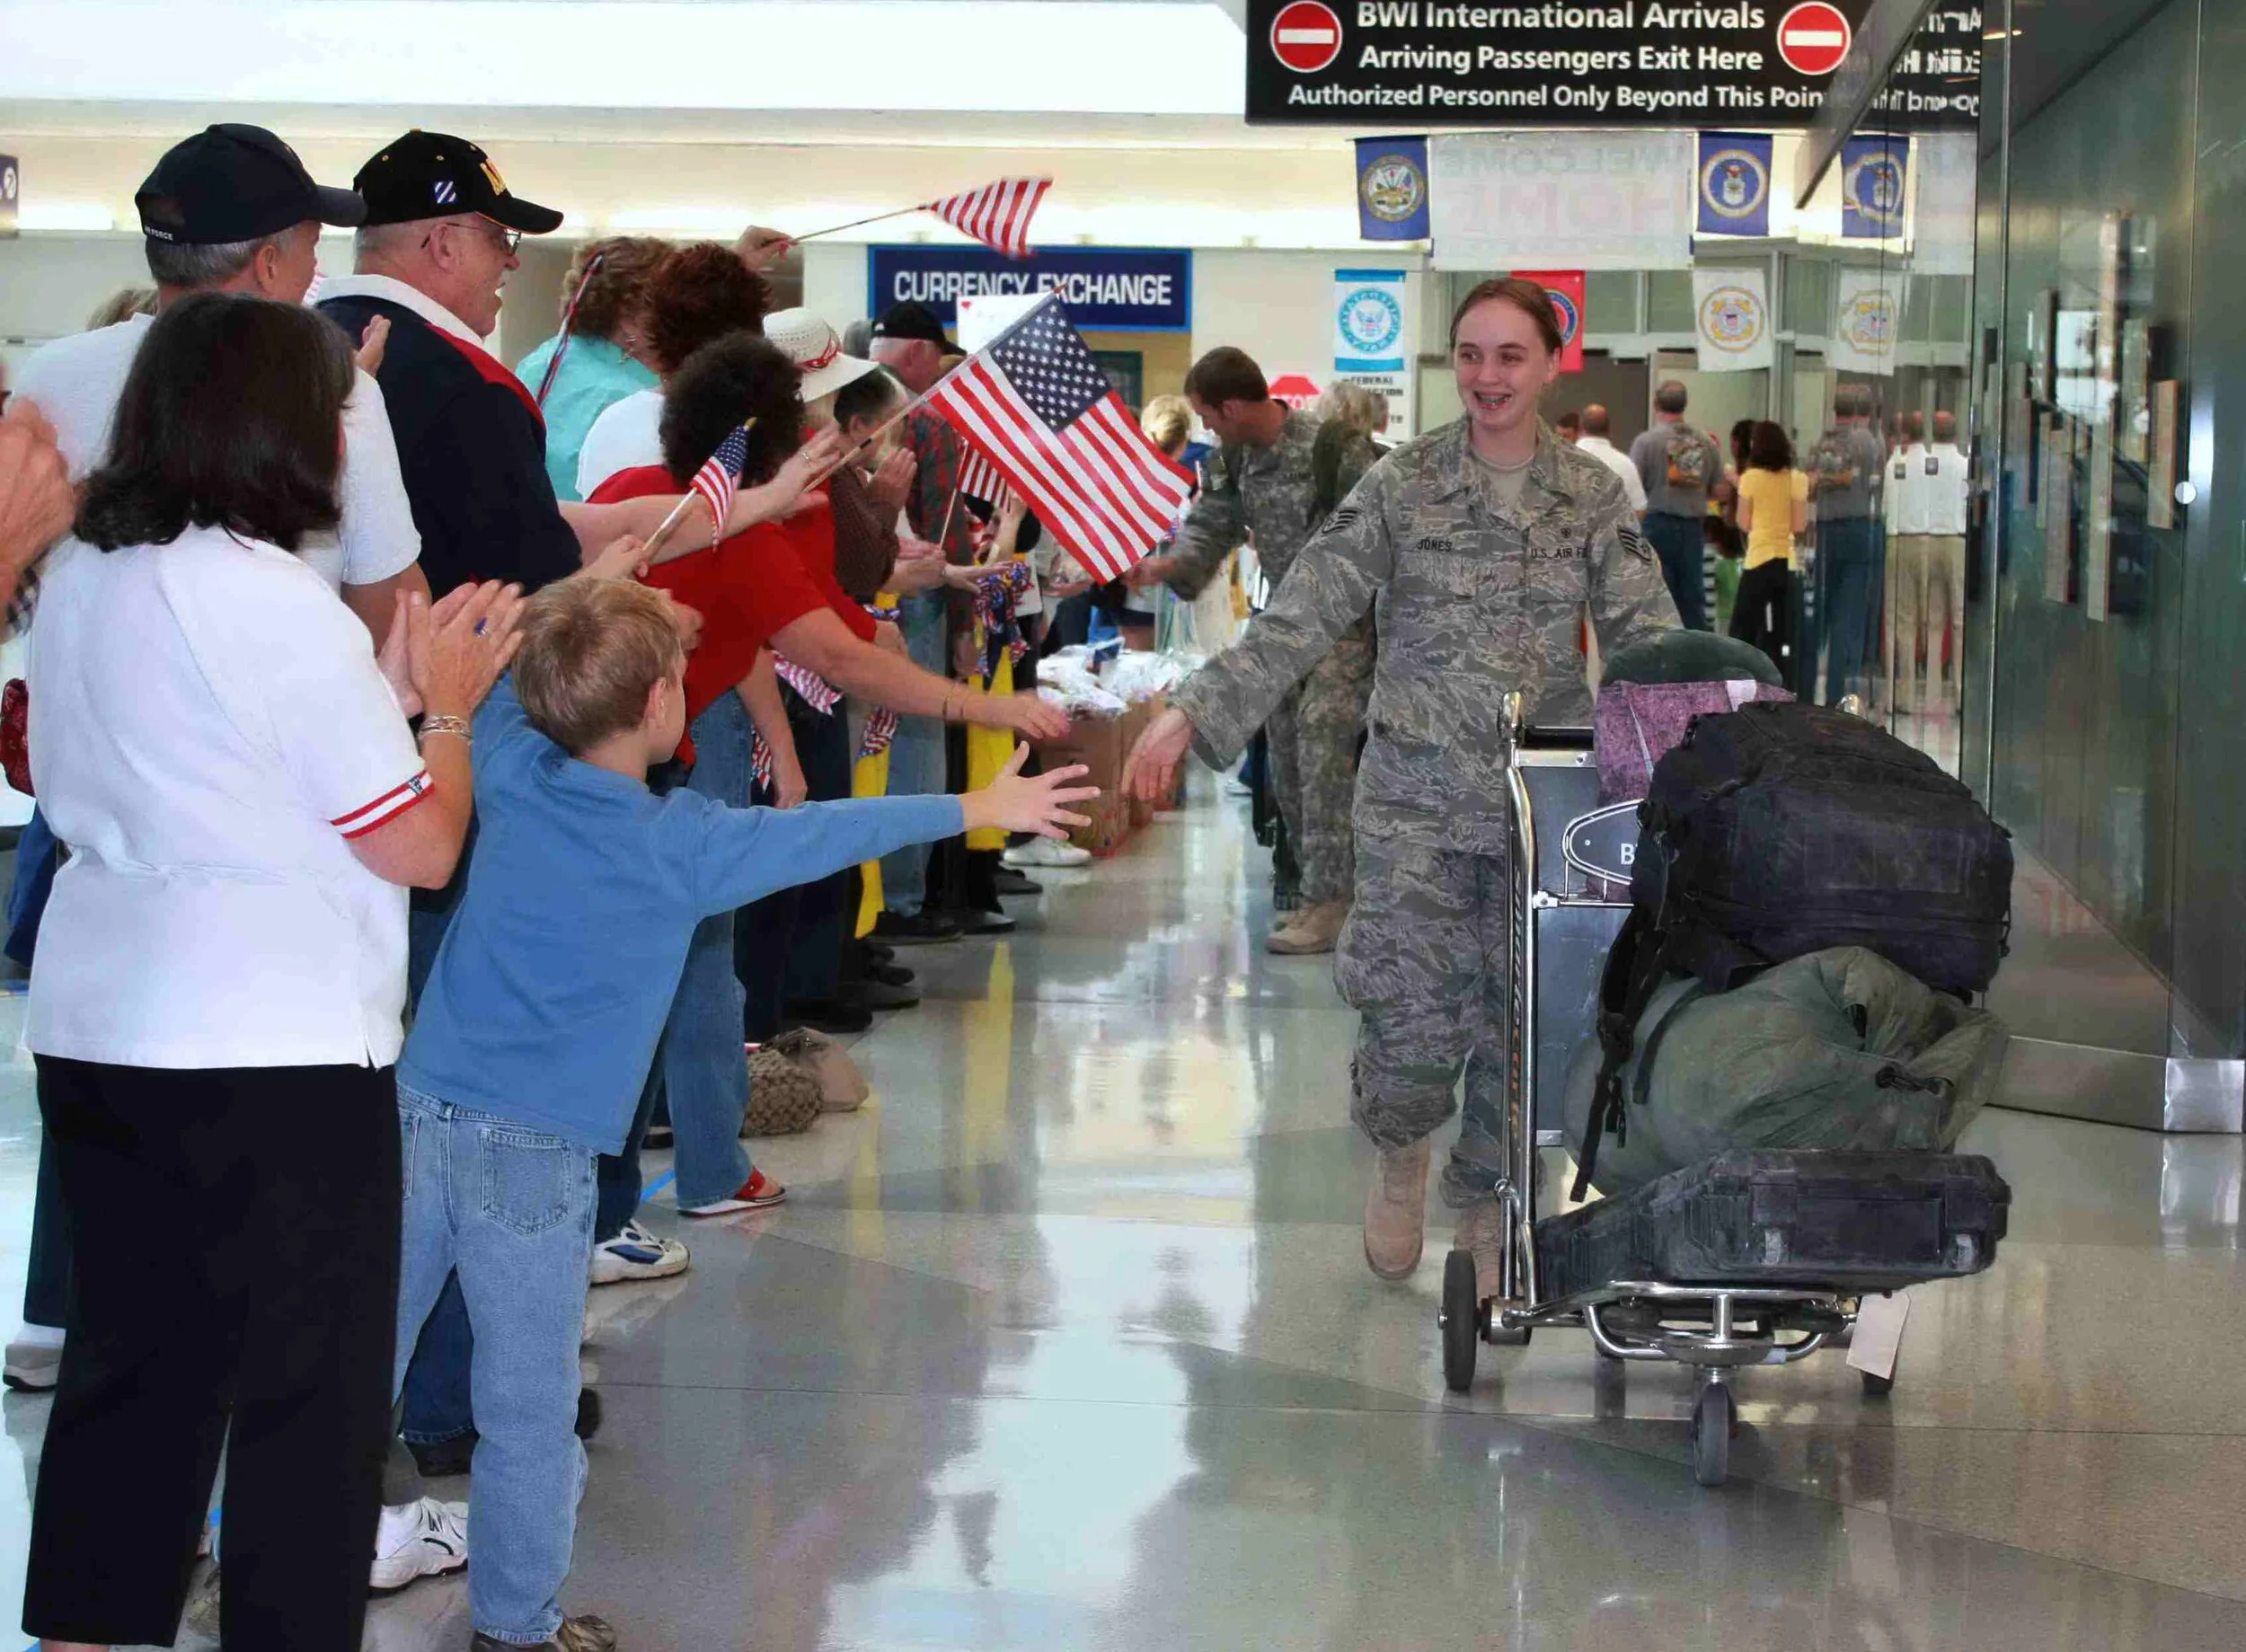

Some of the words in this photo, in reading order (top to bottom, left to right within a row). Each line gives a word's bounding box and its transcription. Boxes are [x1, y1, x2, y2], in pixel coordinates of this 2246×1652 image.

[1357, 1, 1419, 28] BWI
[1426, 1, 1633, 28] International
[1642, 0, 1765, 29] Arrivals
[1358, 44, 1471, 75] Arriving
[1478, 44, 1631, 75] Passengers
[1638, 45, 1691, 70] Exit
[1697, 46, 1764, 71] Here
[1287, 83, 1423, 106] Authorized
[1428, 84, 1547, 106] Personnel
[1552, 84, 1611, 111] Only
[1617, 84, 1709, 112] Beyond
[1714, 85, 1764, 108] This
[1770, 85, 1826, 108] Poin
[893, 269, 1030, 303] CURRENCY
[1037, 272, 1173, 306] EXCHANGE
[1416, 538, 1453, 552] JONES
[1554, 546, 1573, 558] AIR
[1620, 843, 1635, 865] B
